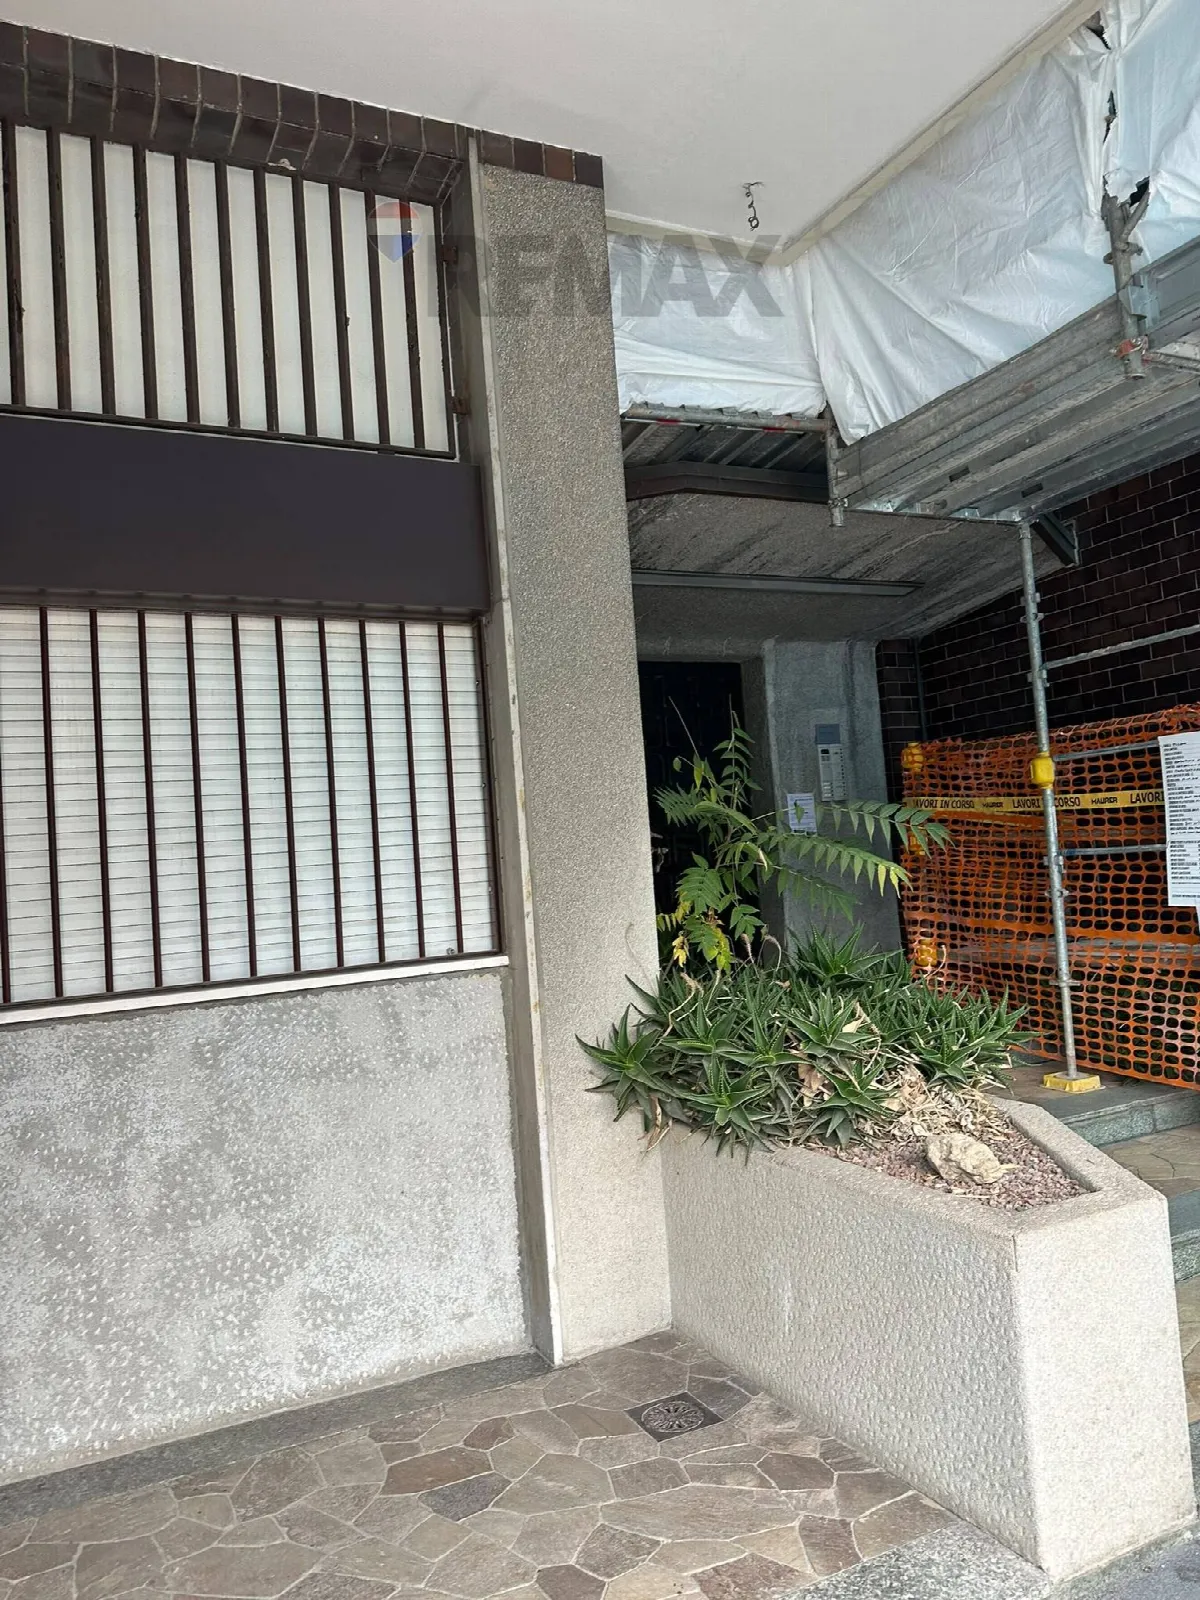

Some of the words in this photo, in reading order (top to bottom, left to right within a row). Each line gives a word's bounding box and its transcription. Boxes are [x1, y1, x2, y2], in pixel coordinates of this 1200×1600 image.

[940, 799, 950, 809] IN
[951, 799, 976, 809] CORSO
[1012, 799, 1041, 809] LAVORI
[1053, 796, 1081, 808] CORSO
